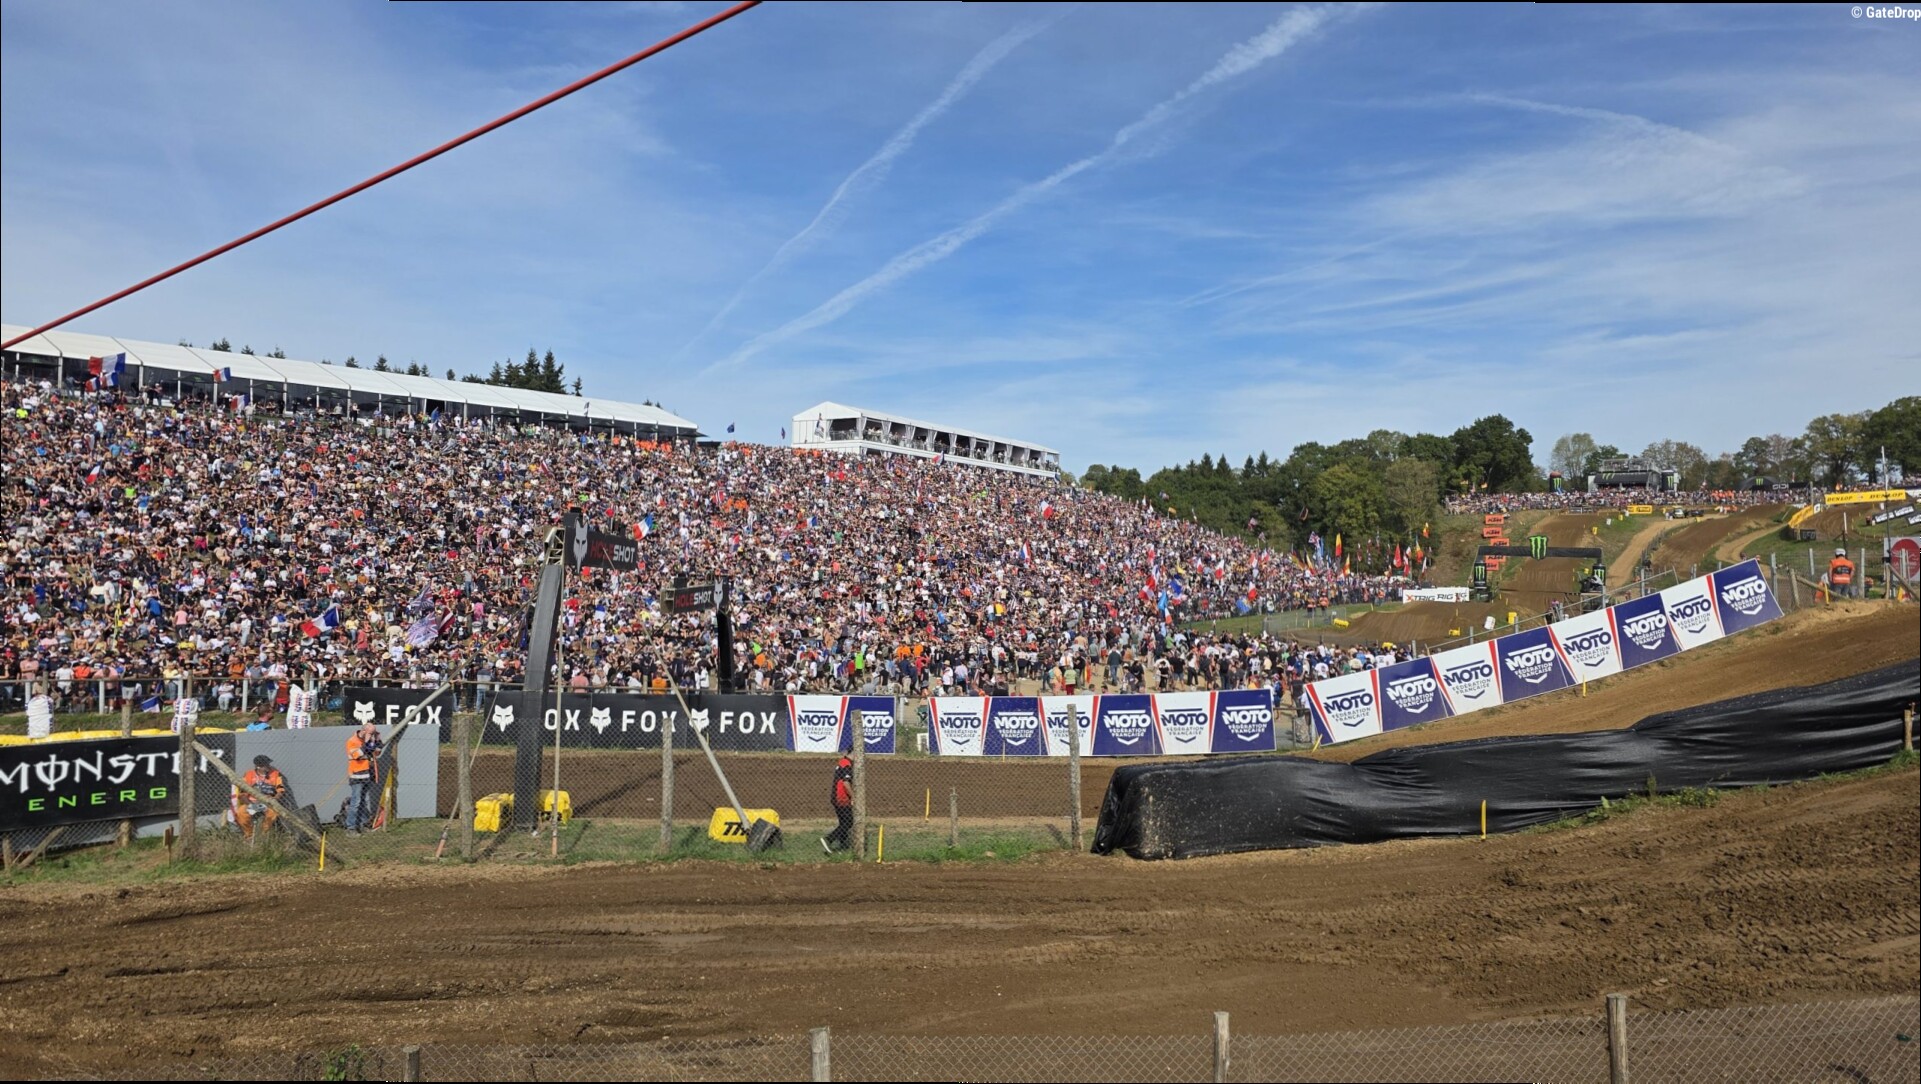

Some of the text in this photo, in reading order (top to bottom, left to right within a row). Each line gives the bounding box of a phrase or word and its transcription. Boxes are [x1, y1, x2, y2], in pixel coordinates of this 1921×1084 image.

[1721, 579, 1767, 604] MOTO
[1669, 598, 1712, 623] MOTO
[1622, 613, 1667, 638] MOTO
[1563, 631, 1612, 655] MOTO
[1573, 645, 1611, 660] FÉDÉRATION
[1504, 647, 1556, 672] MOTO
[1443, 663, 1493, 687] MOTO
[1452, 678, 1491, 692] FÉDÉRATION
[1386, 677, 1437, 701] MOTO
[1456, 683, 1490, 695] FRANÇAISE
[1324, 692, 1374, 715] MOTO
[386, 704, 443, 727] FOX
[544, 709, 581, 732] OX
[621, 710, 678, 733] FOX
[719, 711, 777, 734] FOX
[797, 714, 838, 727] MOTO
[862, 715, 894, 728] OTO
[940, 716, 982, 729] MOTO
[994, 716, 1039, 729] MOTO
[1047, 716, 1090, 729] MOO
[1103, 714, 1151, 728] MOTO
[1161, 712, 1208, 726] MOTO
[1222, 709, 1272, 725] MOTO
[28, 787, 168, 812] ENERG
